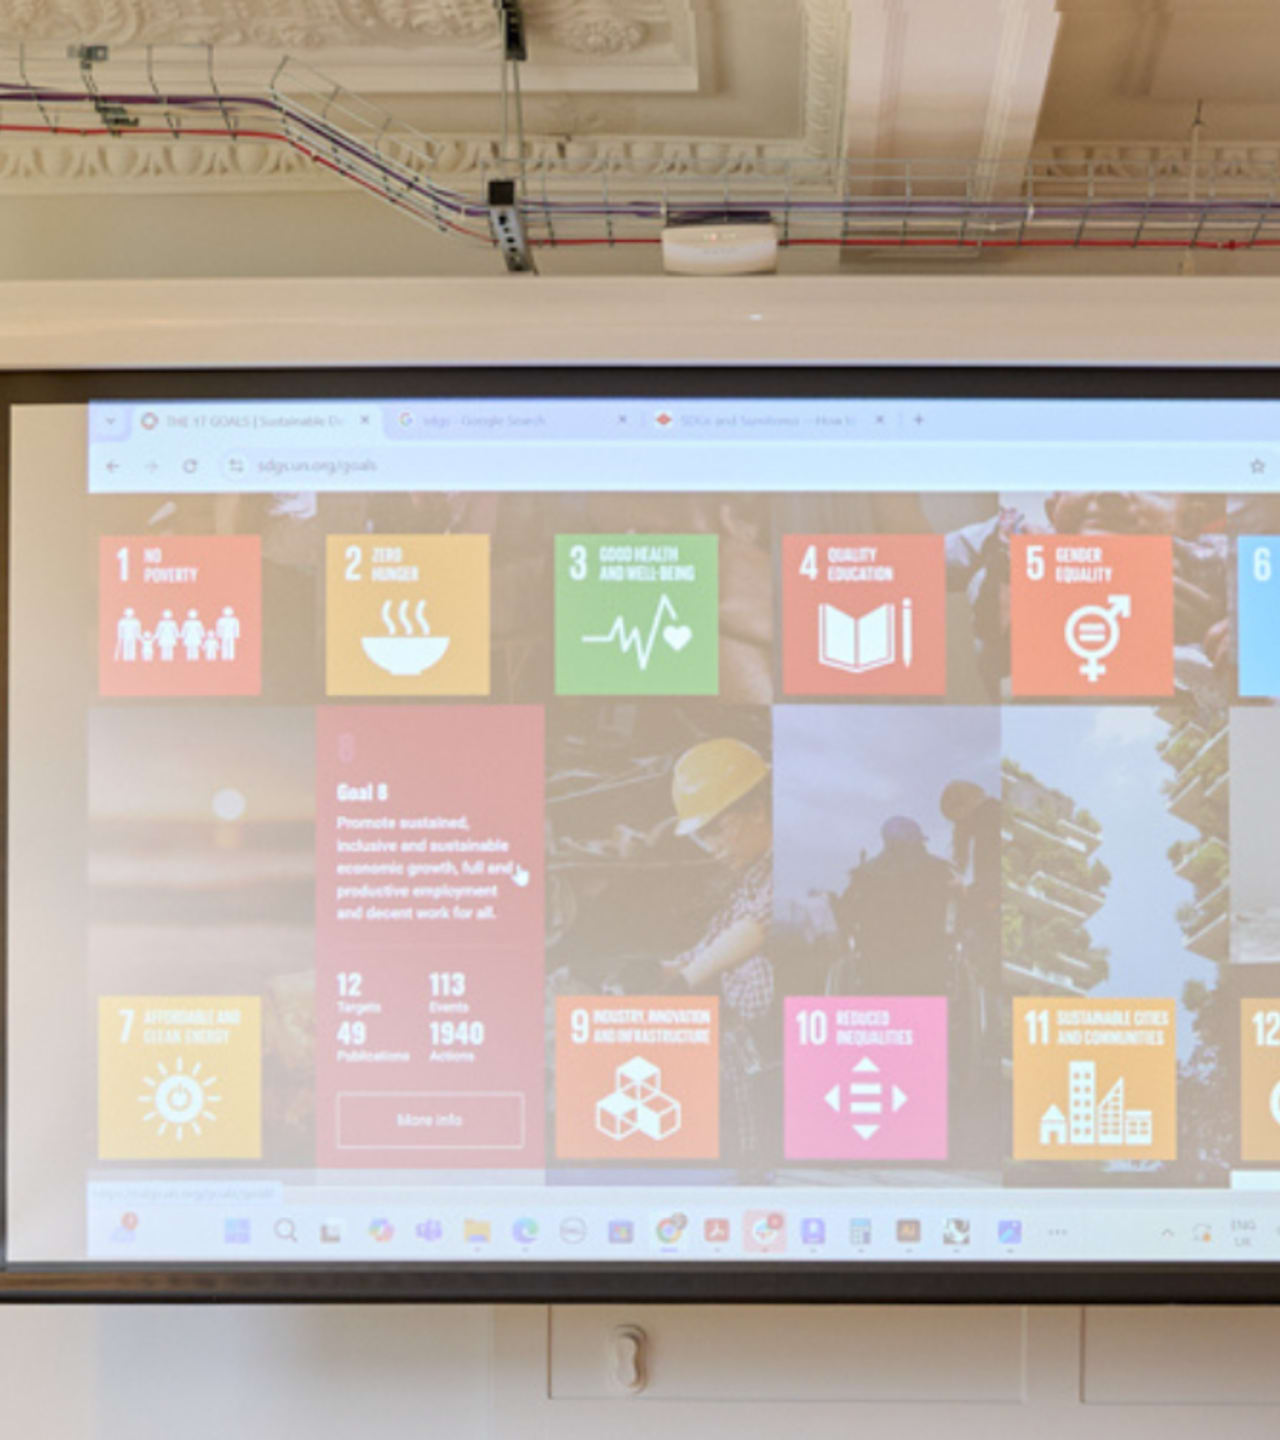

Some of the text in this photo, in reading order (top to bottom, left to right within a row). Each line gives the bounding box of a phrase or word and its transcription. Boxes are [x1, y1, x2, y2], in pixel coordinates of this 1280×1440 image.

[117, 547, 129, 582] 1
[344, 546, 362, 581] 2
[569, 545, 587, 581] 3
[799, 545, 819, 580] 4
[1026, 545, 1045, 580] 5
[1253, 547, 1271, 582] 6
[400, 838, 428, 853] and
[429, 838, 510, 853] sustainable
[337, 861, 405, 876] economic
[337, 883, 499, 901] productive employment
[337, 904, 364, 920] and
[365, 904, 413, 920] decent
[337, 971, 363, 998] 12
[429, 971, 466, 998] 113
[117, 1008, 135, 1045] 7
[336, 1020, 367, 1046] 49
[428, 1020, 485, 1046] 1940
[570, 1009, 589, 1044] 9
[795, 1010, 827, 1044] 10
[1024, 1010, 1049, 1044] 11
